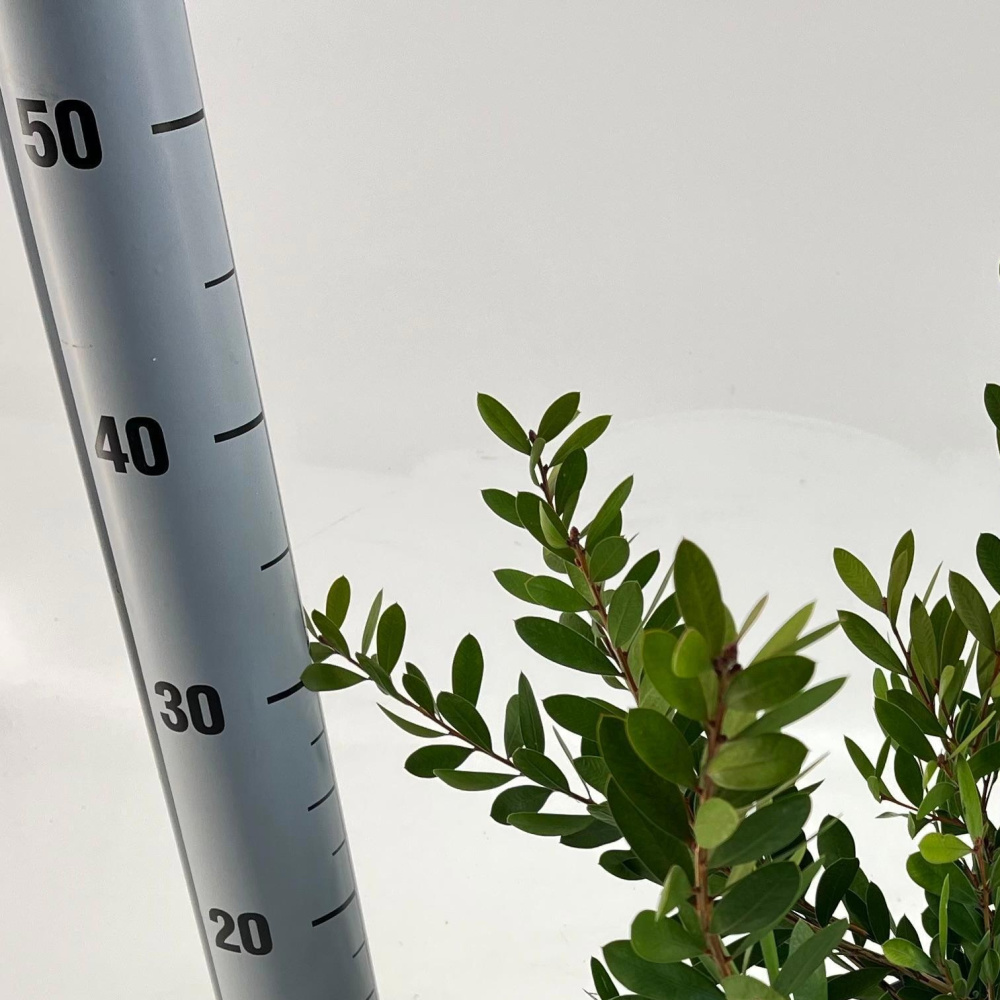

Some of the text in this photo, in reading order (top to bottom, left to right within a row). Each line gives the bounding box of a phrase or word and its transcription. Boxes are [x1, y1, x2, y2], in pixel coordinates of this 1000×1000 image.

[17, 98, 103, 170] 50
[95, 415, 170, 477] 40
[154, 681, 226, 736] 30
[208, 908, 274, 956] 20
